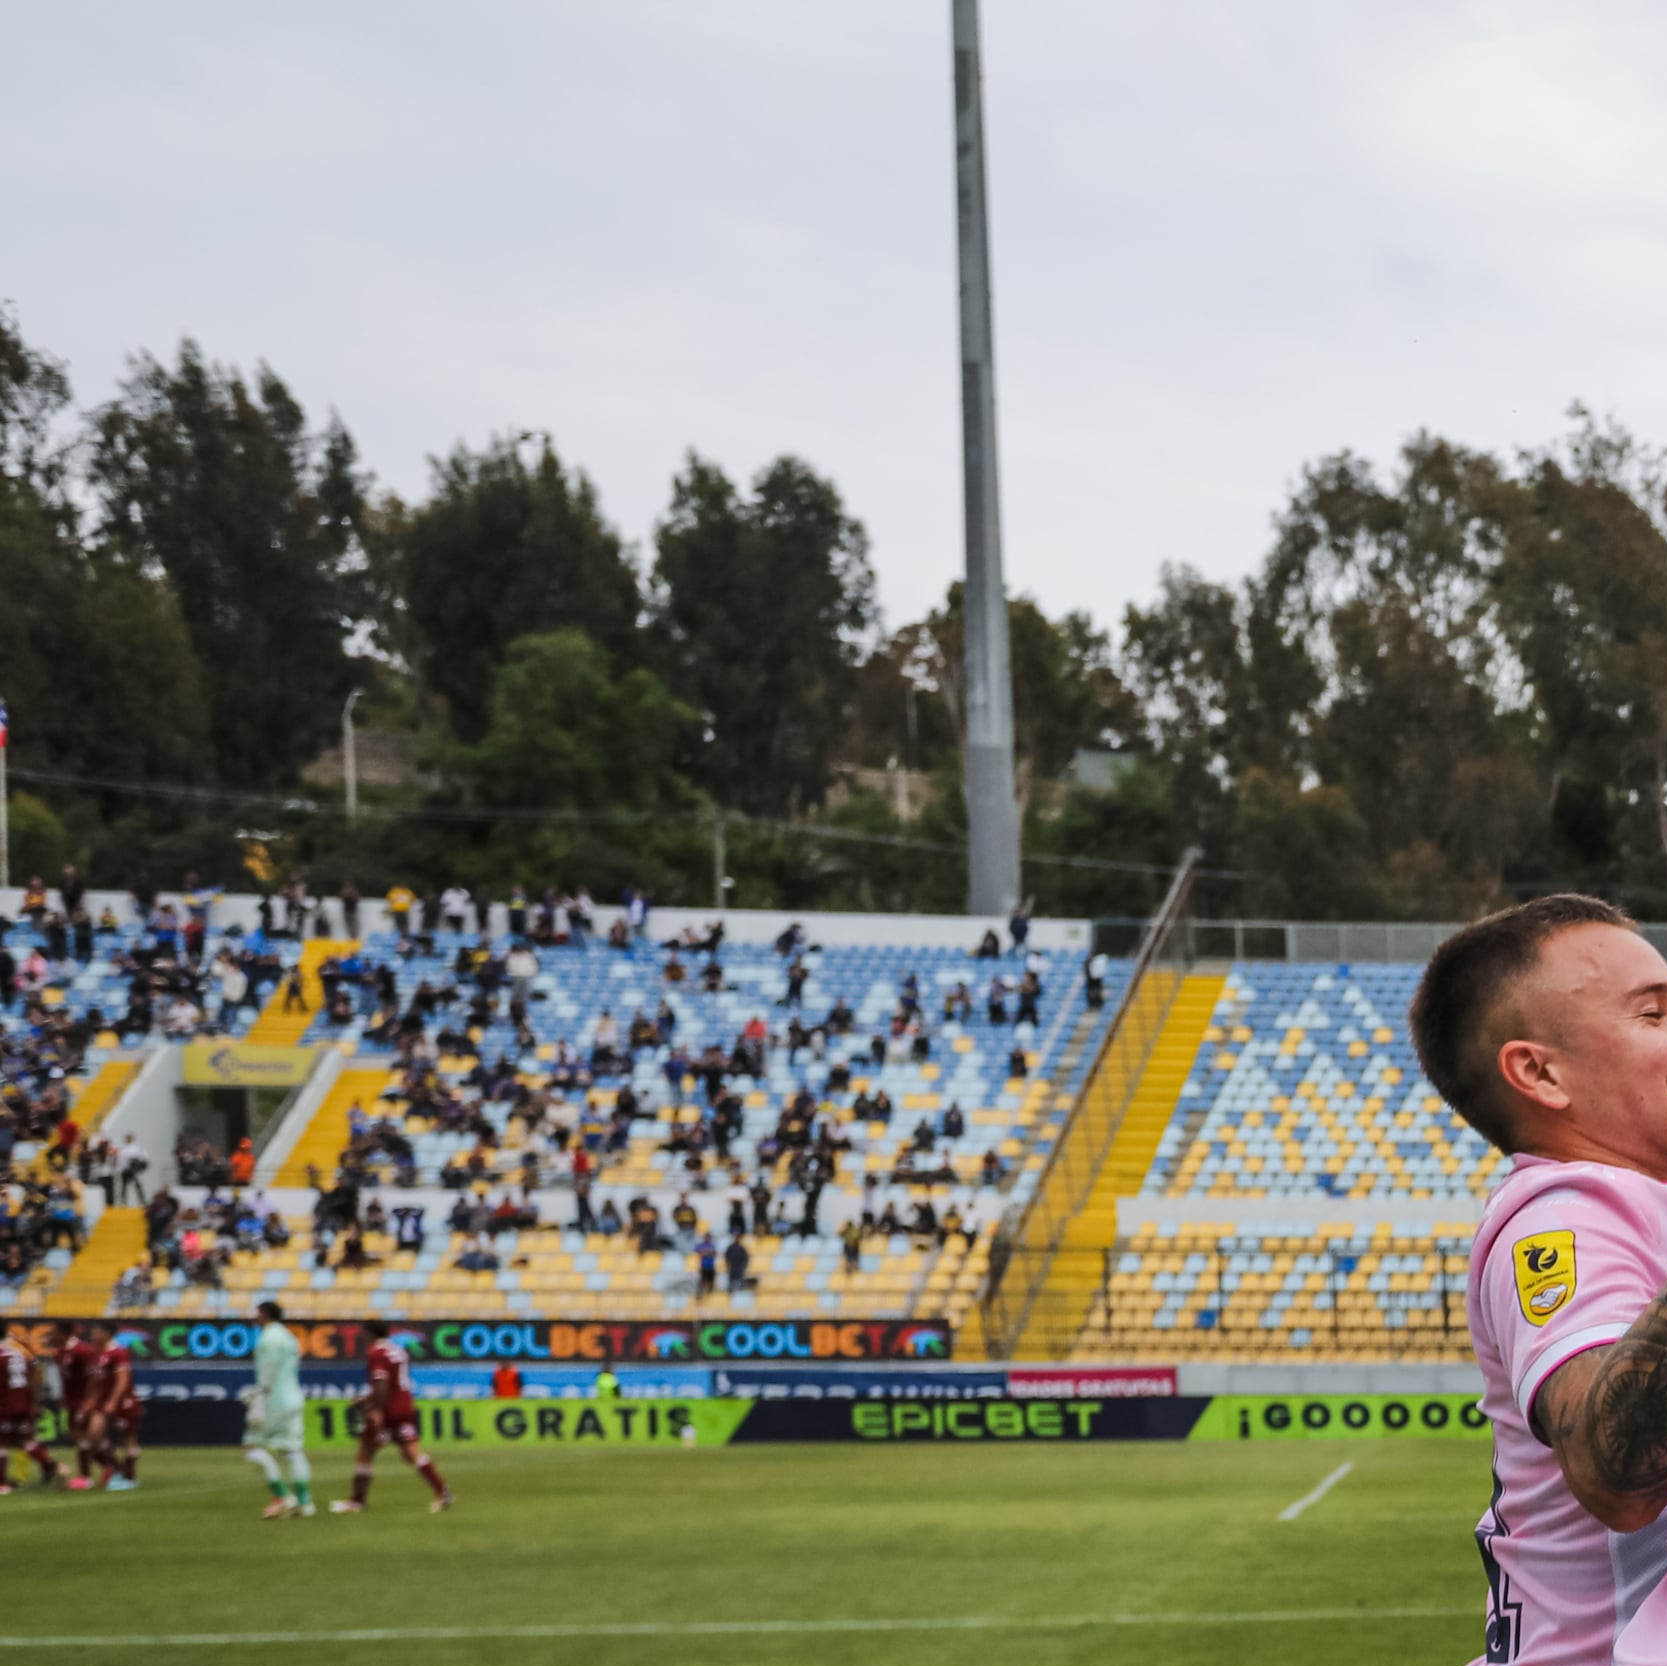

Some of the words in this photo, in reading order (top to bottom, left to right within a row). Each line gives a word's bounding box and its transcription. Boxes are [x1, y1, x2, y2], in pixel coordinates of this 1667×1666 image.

[158, 1322, 362, 1358] COOET
[494, 1406, 693, 1441] GRATIS
[852, 1402, 1101, 1438] EPICBET
